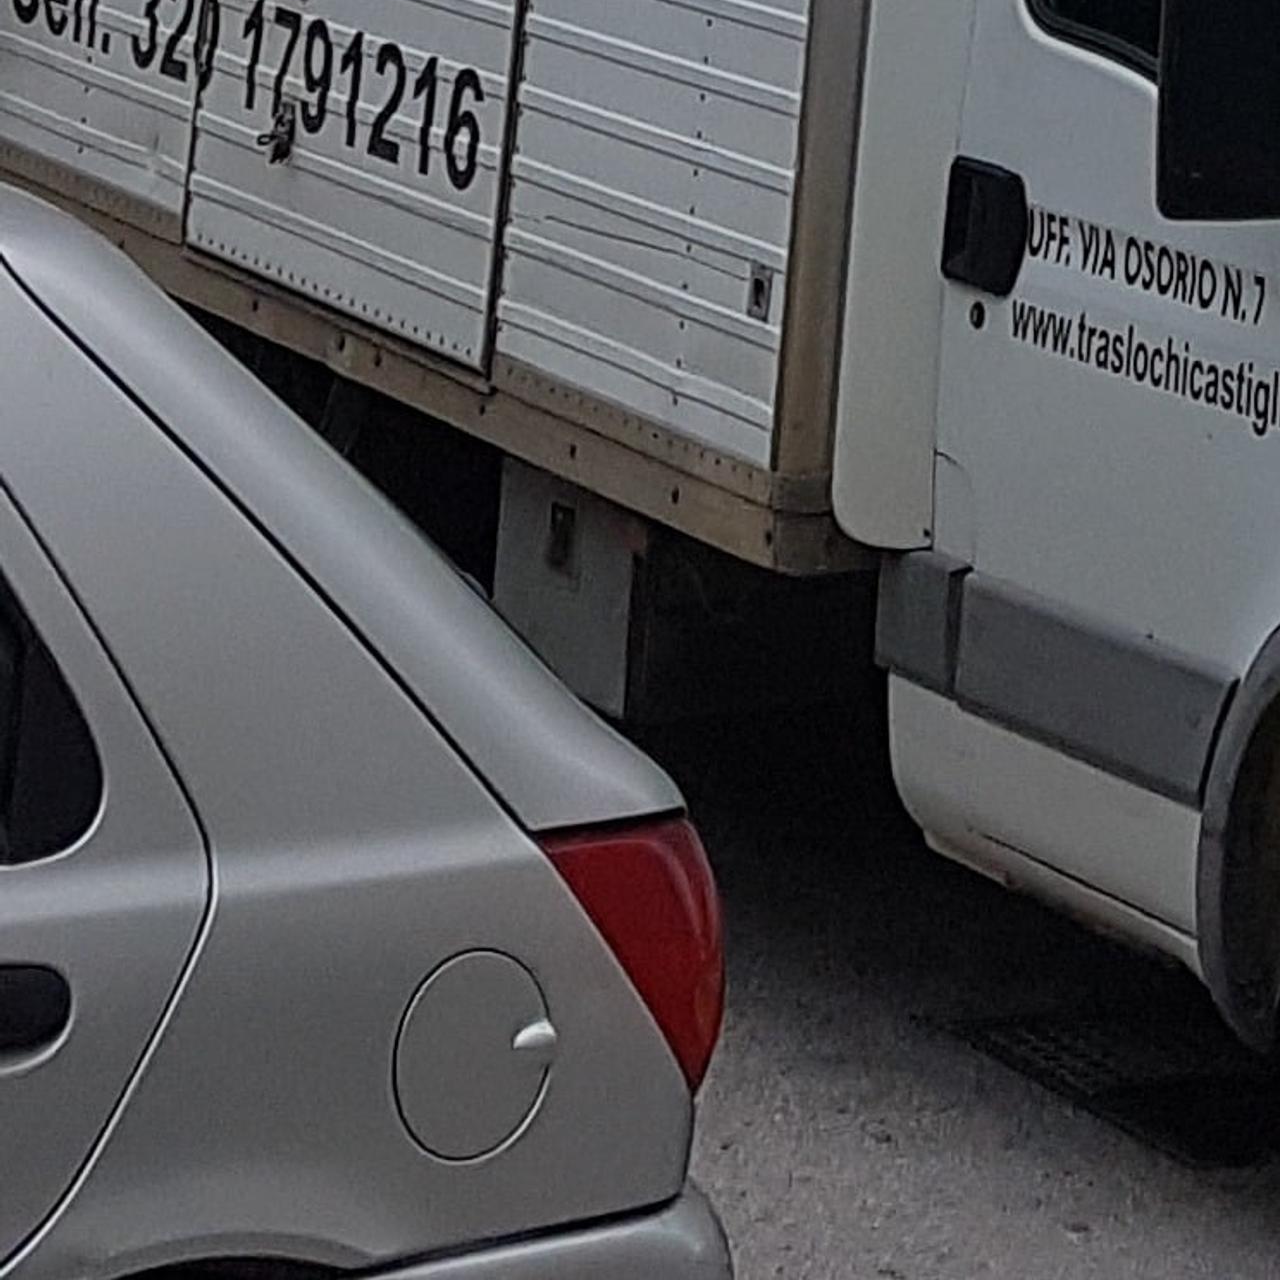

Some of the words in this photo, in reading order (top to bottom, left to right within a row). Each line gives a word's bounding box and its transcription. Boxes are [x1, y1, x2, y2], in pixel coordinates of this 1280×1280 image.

[1028, 209, 1071, 267] UFF.
[1078, 220, 1116, 281] VIA
[1124, 235, 1217, 310] OSORIO
